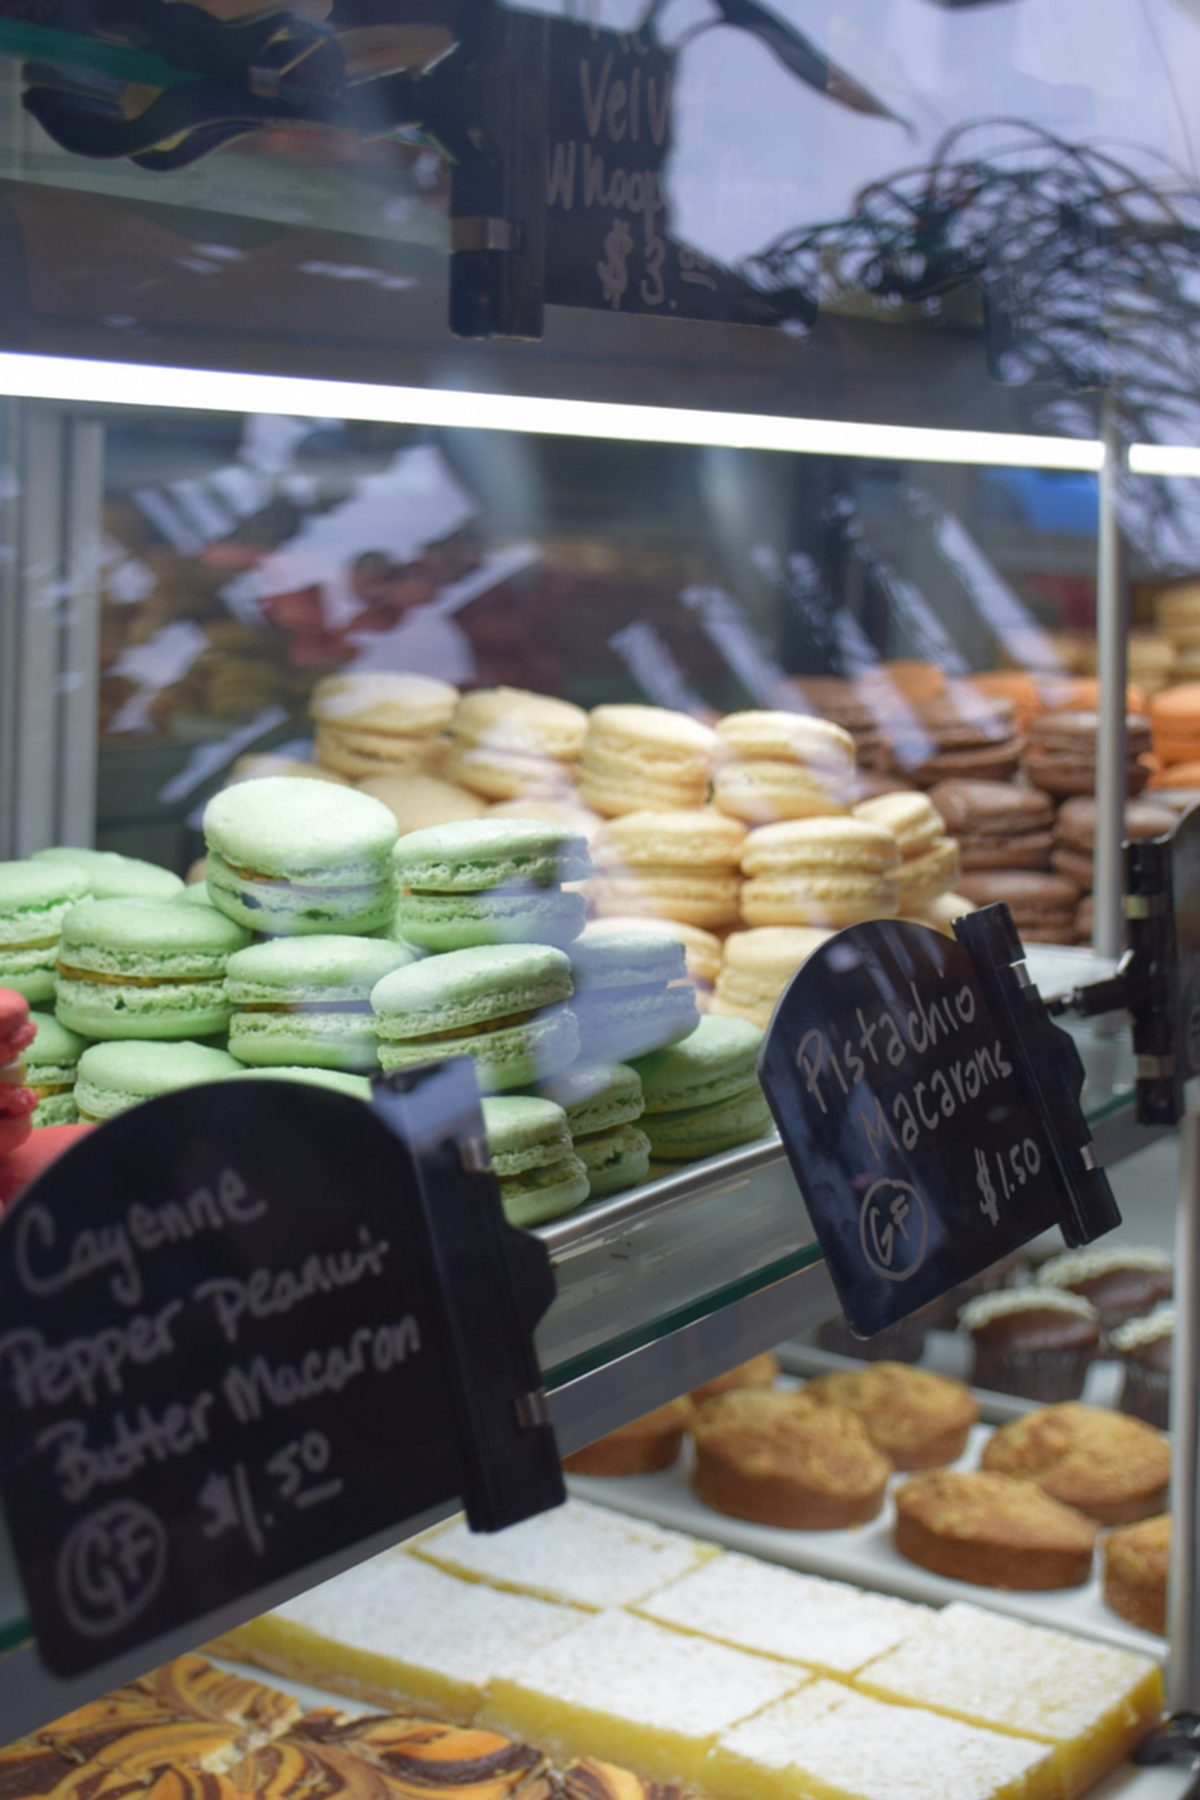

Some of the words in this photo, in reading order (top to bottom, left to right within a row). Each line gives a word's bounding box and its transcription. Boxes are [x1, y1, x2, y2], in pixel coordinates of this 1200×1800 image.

[579, 51, 673, 146] Velv
[546, 140, 665, 241] Whoop
[858, 1040, 1013, 1164] Macarons
[14, 1167, 268, 1306] Cayenne
[974, 1137, 1043, 1227] $1.50
[0, 1299, 183, 1409] Pepper
[194, 1225, 390, 1343] Peanut
[36, 1393, 215, 1501] Butter
[221, 1313, 420, 1424] Macaron
[199, 1430, 343, 1555] $1.50
[74, 1512, 153, 1610] GF
